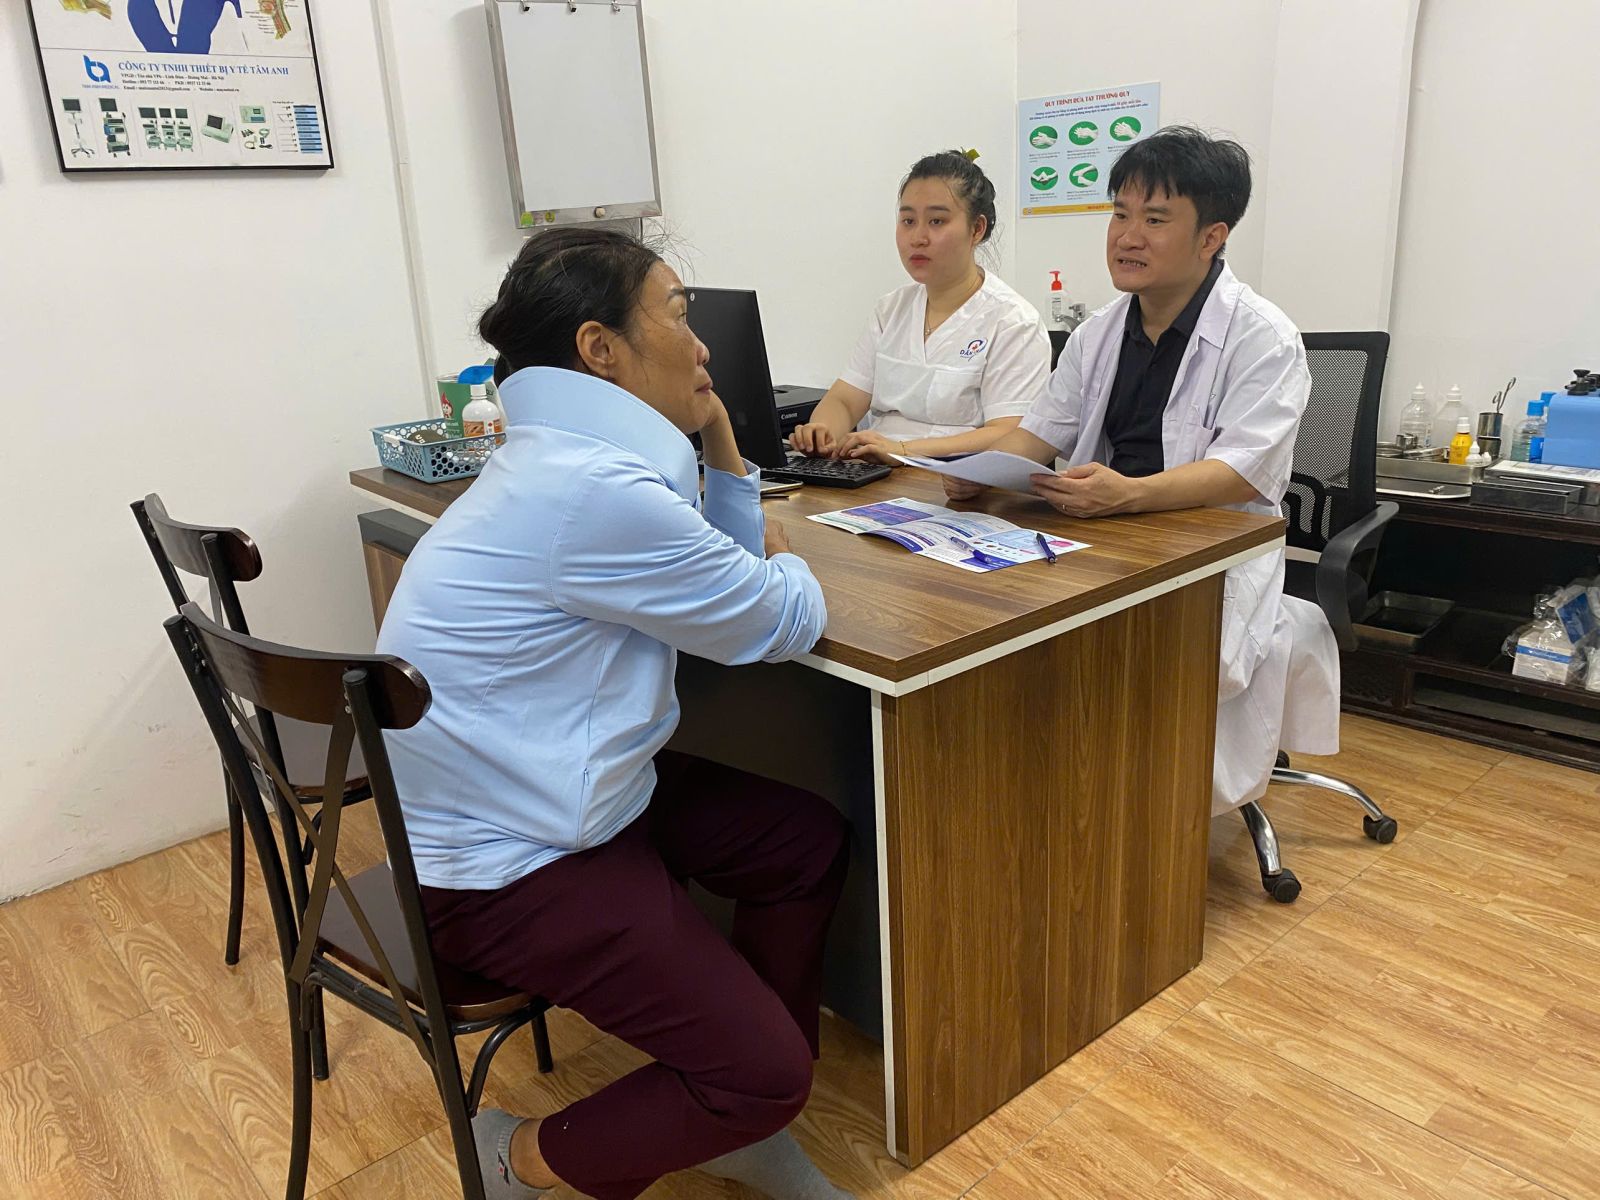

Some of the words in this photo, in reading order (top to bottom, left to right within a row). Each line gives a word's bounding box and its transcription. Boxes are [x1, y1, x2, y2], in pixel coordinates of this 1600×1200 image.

[118, 61, 146, 71] CÔNG
[149, 63, 160, 72] TY
[162, 63, 188, 72] TNHH
[271, 67, 289, 75] ANH
[781, 412, 798, 420] Canon
